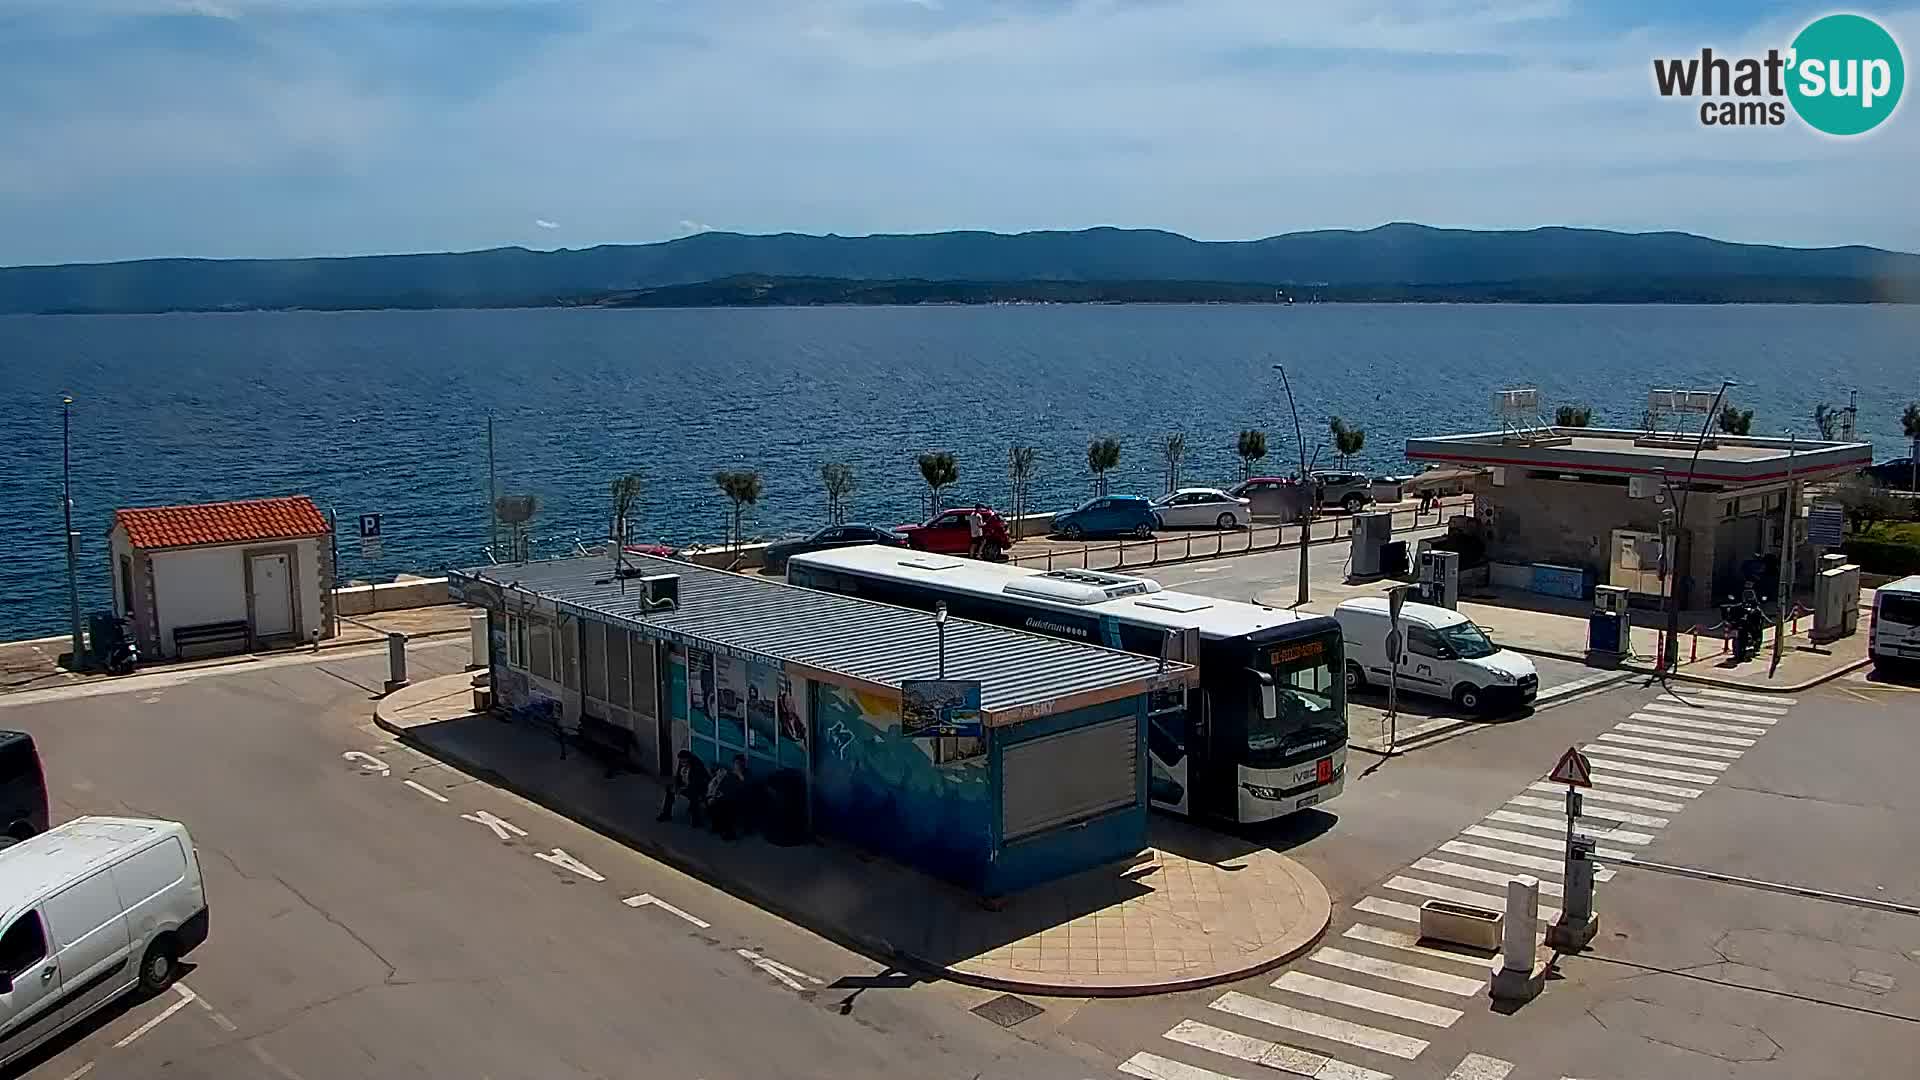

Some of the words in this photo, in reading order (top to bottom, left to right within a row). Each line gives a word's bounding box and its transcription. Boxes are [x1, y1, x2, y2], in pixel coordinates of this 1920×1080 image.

[363, 517, 376, 534] P
[698, 640, 728, 655] STATION
[730, 649, 754, 662] TICKET
[755, 656, 783, 669] OFFICE
